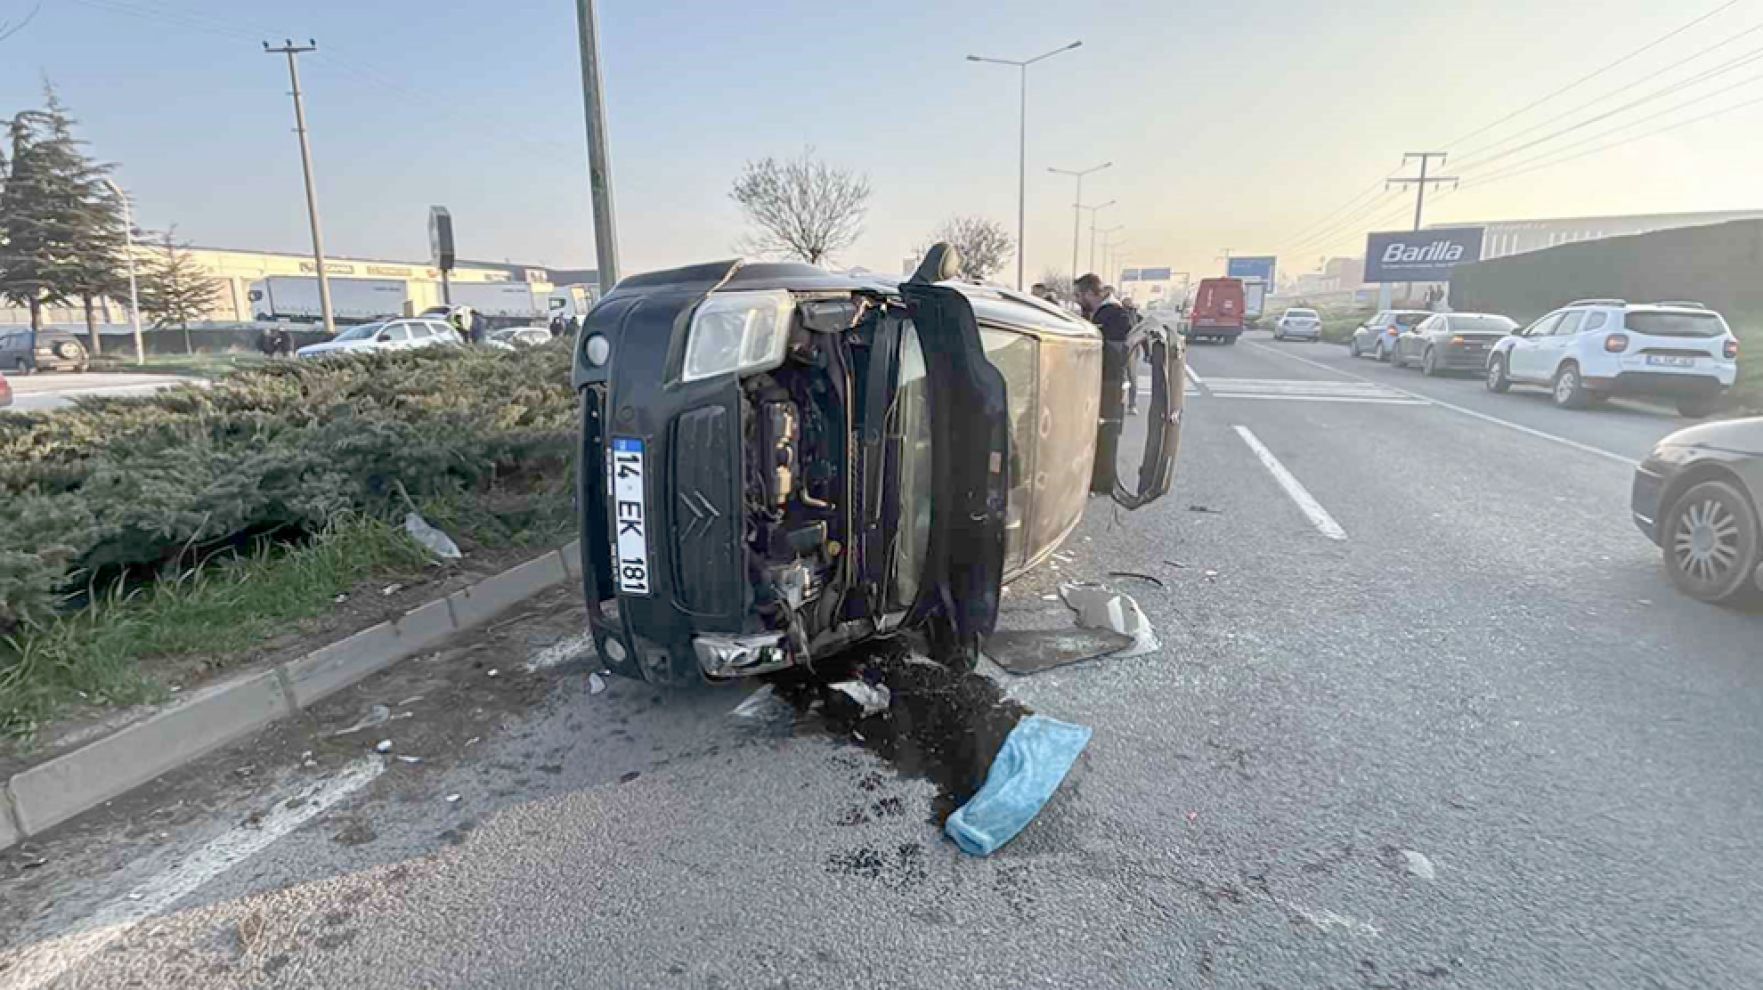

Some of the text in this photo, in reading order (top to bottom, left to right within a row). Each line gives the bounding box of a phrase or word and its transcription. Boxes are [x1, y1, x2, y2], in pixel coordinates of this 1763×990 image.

[1382, 240, 1464, 262] Barilla
[616, 455, 646, 590] 14 EK 181
